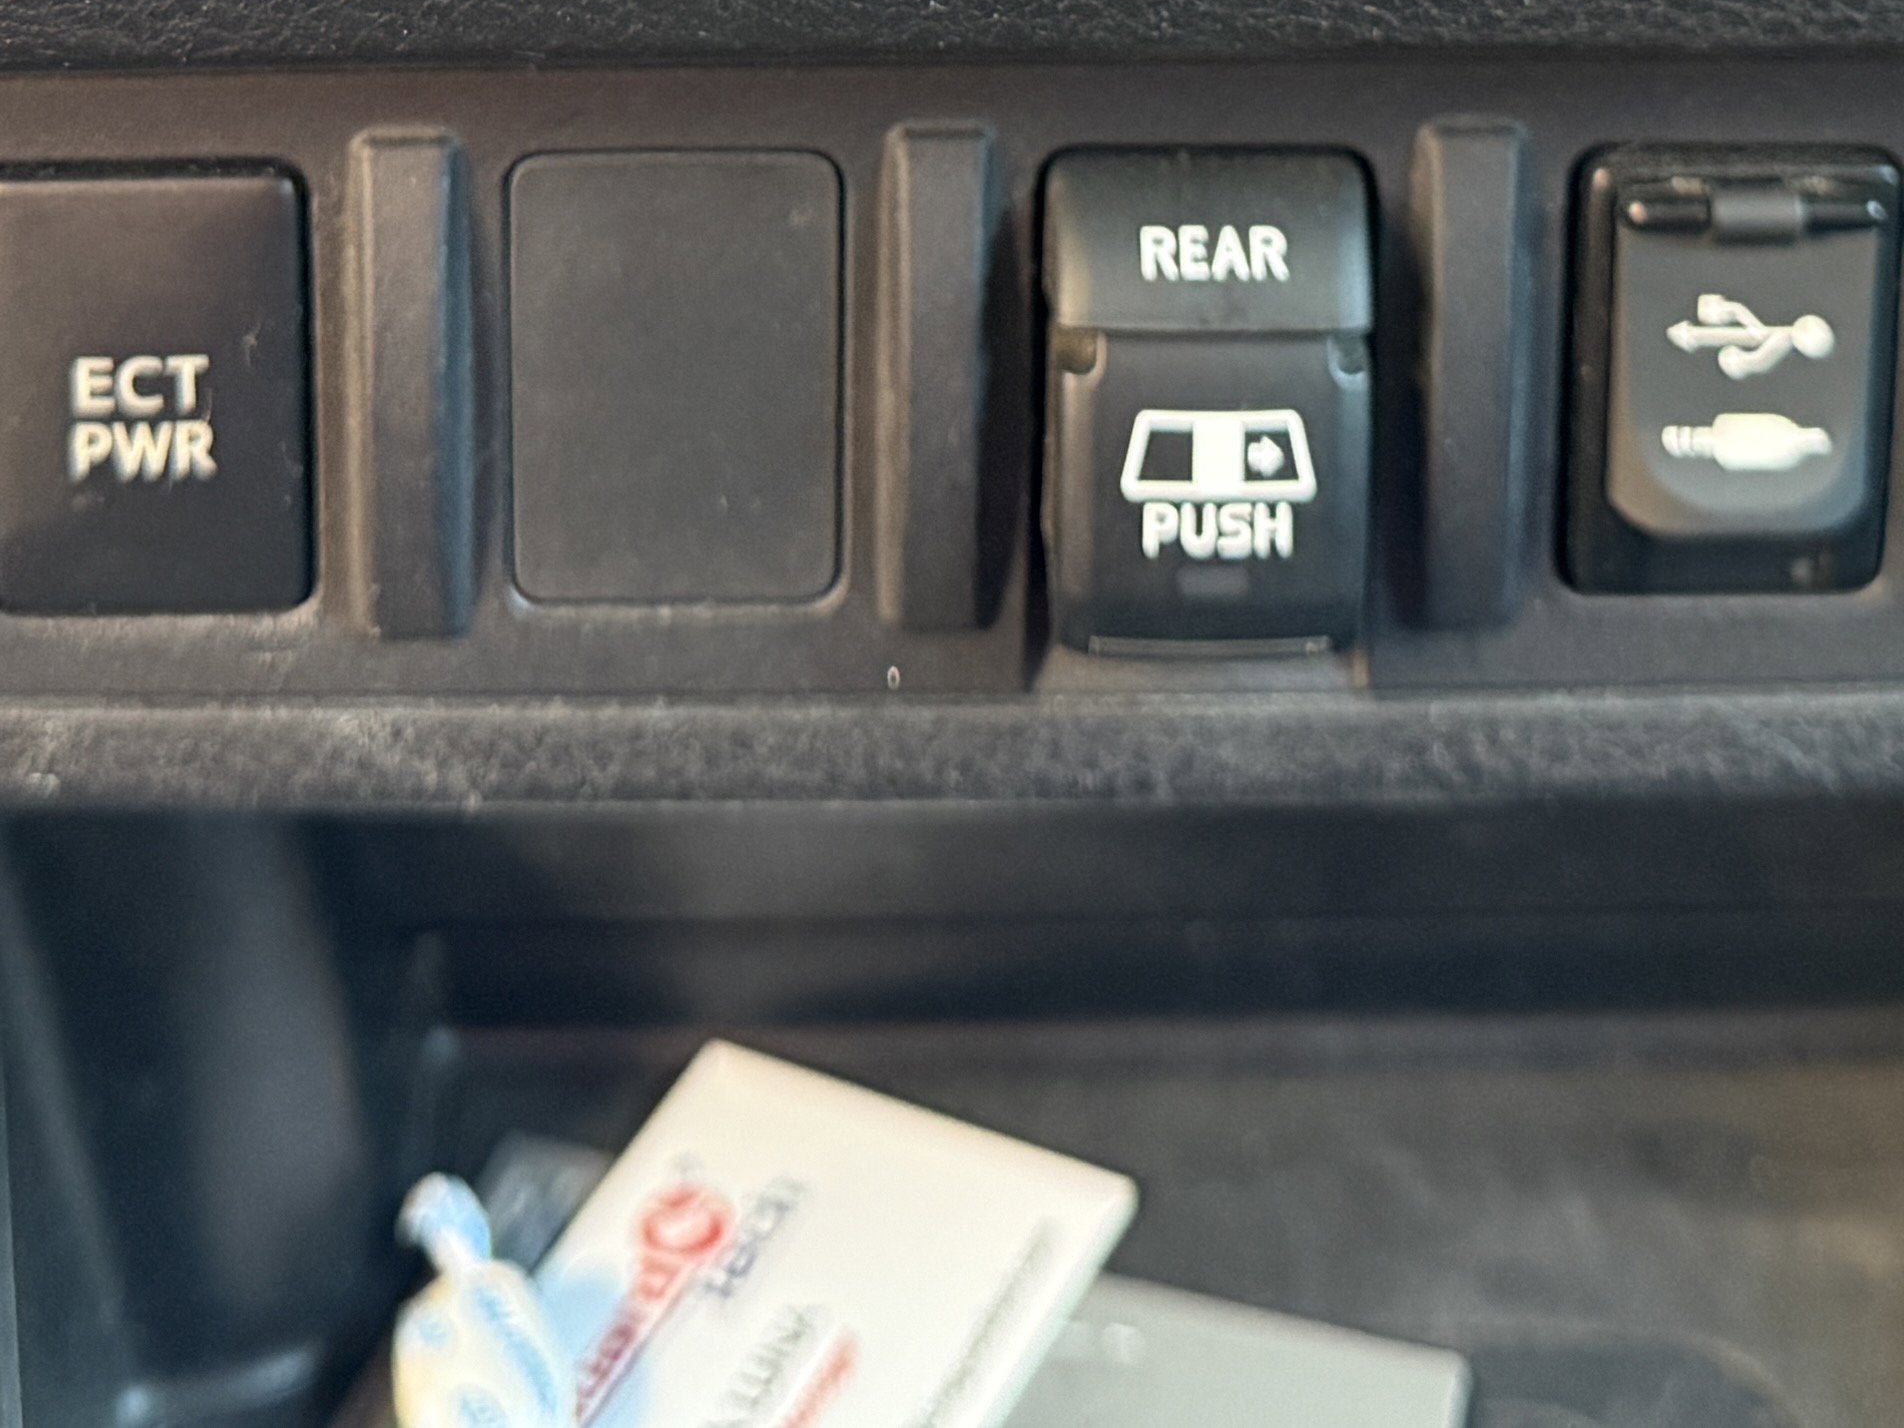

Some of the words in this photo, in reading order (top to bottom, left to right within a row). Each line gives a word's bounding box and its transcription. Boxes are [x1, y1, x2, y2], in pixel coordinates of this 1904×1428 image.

[1139, 224, 1291, 282] REAR
[70, 354, 210, 418] ECT
[69, 419, 218, 483] PWR
[1141, 501, 1295, 560] PUSH
